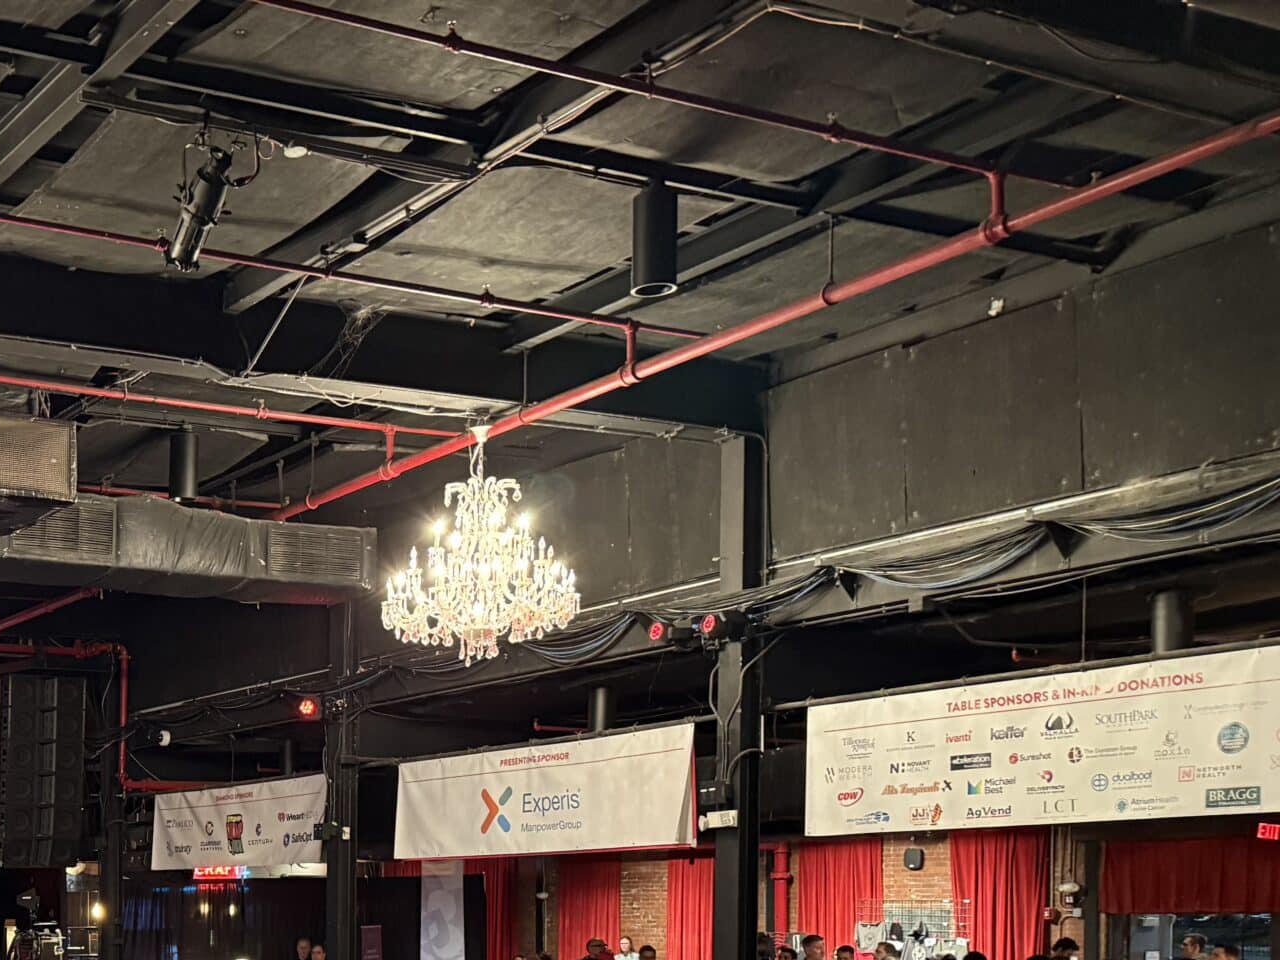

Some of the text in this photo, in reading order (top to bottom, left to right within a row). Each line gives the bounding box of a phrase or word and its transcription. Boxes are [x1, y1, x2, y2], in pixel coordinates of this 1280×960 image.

[946, 699, 981, 713] TABLE
[983, 690, 1049, 709] SPONSORS
[1051, 689, 1060, 700] &
[1118, 671, 1205, 692] DONATIONS
[907, 731, 916, 742] K
[945, 731, 971, 743] ivanti
[500, 752, 570, 767] PRESENTING SPONSOR
[1020, 751, 1052, 762] Sureshot
[985, 776, 1016, 786] Michael
[985, 786, 1003, 794] Best
[1208, 788, 1257, 801] BRAGG
[522, 788, 580, 817] Experis
[521, 820, 582, 833] ManpowerGroup
